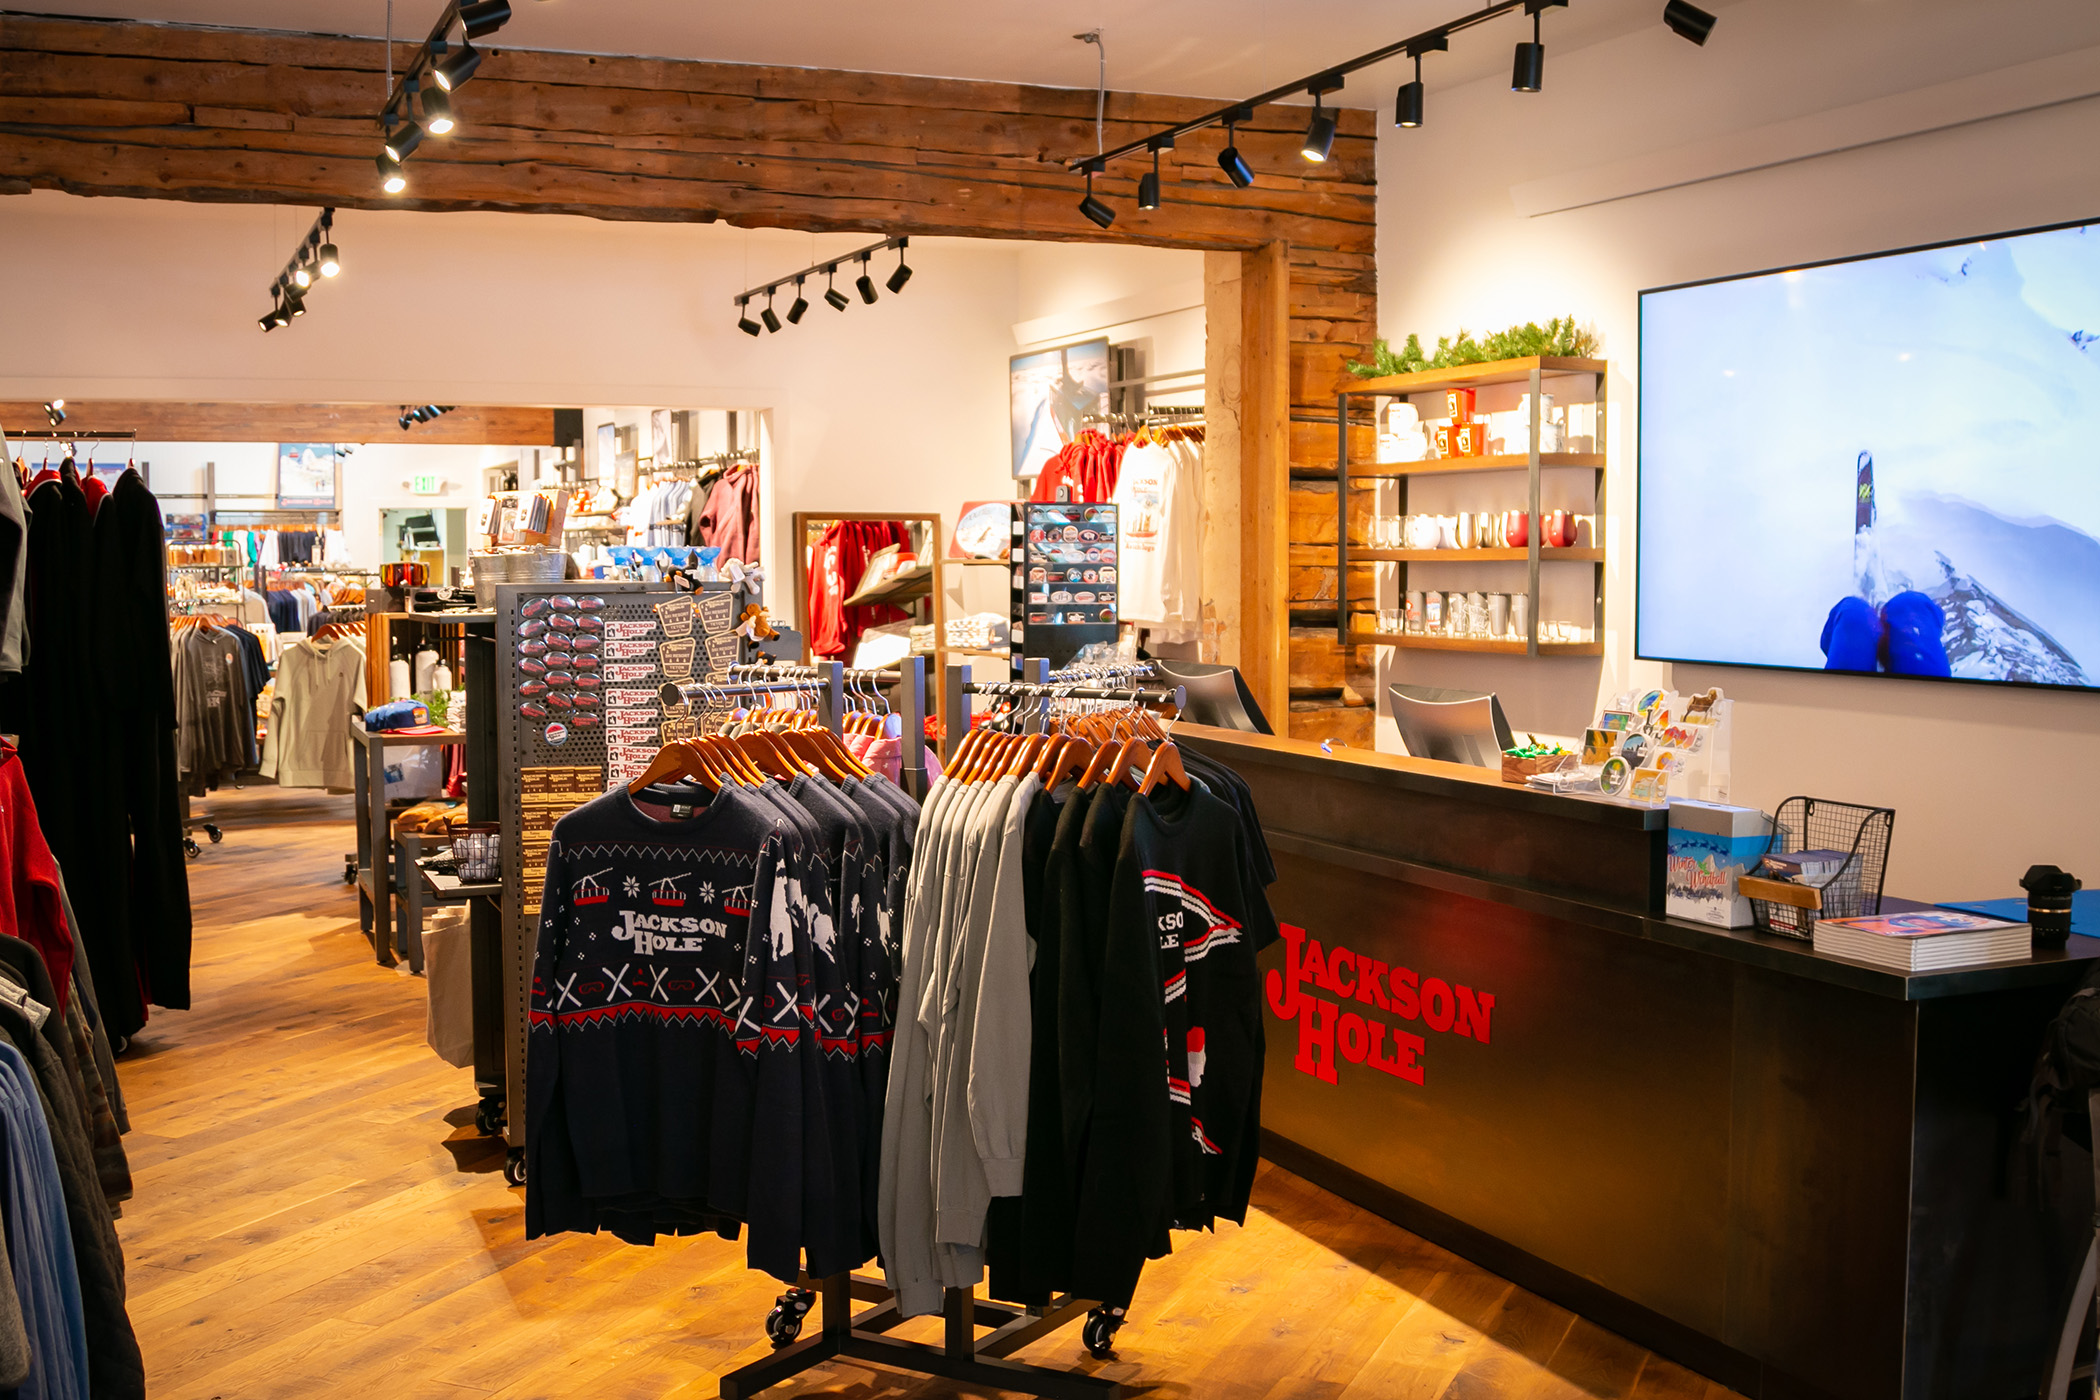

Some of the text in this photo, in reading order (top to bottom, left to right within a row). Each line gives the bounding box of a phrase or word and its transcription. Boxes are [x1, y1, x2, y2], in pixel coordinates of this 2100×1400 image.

[415, 476, 435, 491] EXIT
[616, 623, 654, 632] JACKSON
[616, 643, 654, 652] JACKSON
[616, 666, 653, 675] JACKSON
[618, 691, 655, 700] JACKSON
[618, 711, 655, 720] JACKSON
[618, 730, 656, 739] JACKSON
[620, 747, 657, 756] JACKSON
[621, 764, 647, 773] JACKS
[1668, 854, 1697, 872] Winter
[1686, 870, 1726, 888] Windfall
[611, 910, 728, 942] JACKSON
[633, 935, 703, 955] HOLE
[1266, 922, 1496, 1044] JACKSON
[1295, 994, 1425, 1086] HOLE
